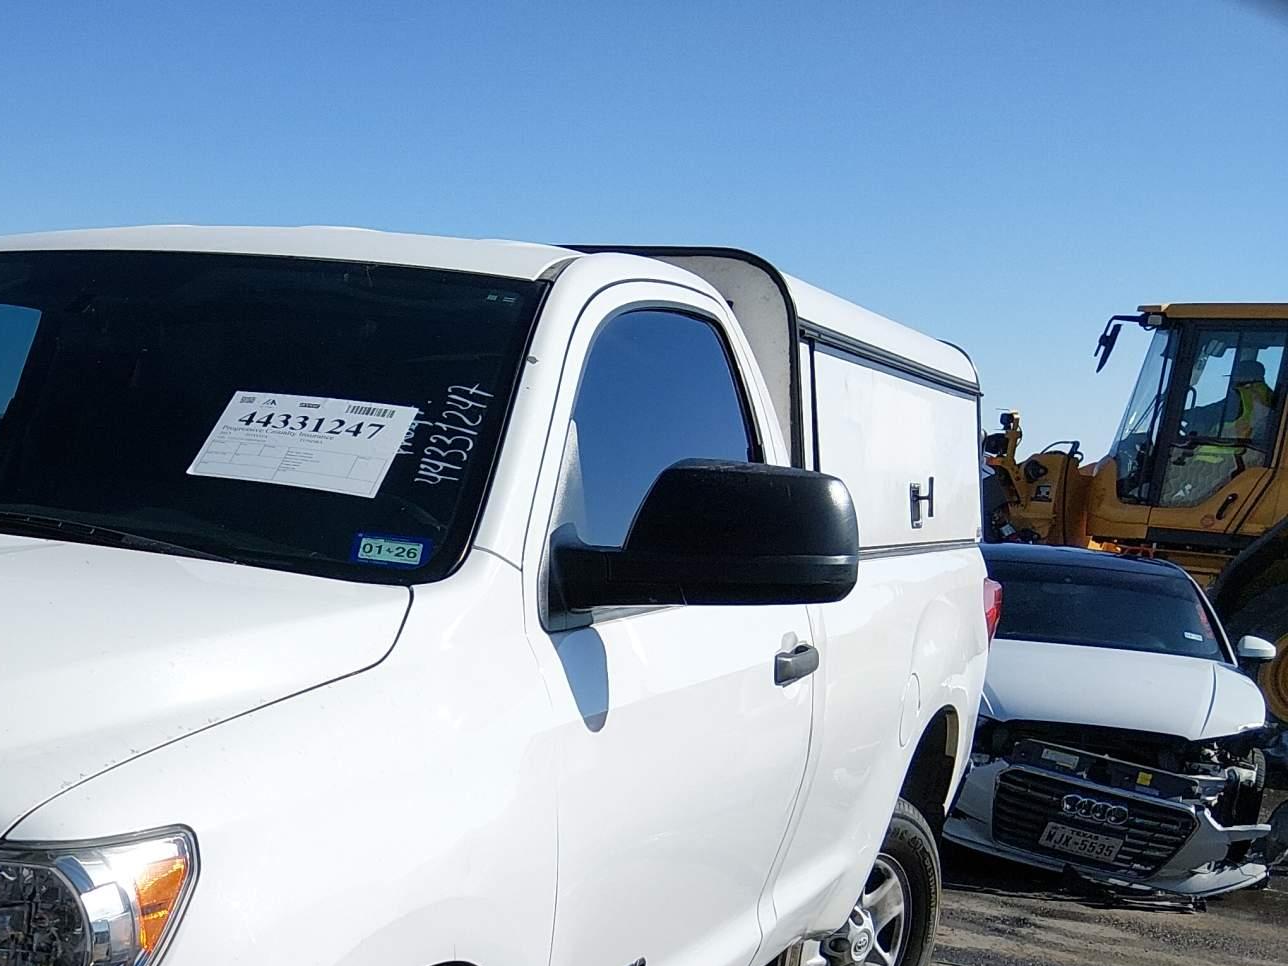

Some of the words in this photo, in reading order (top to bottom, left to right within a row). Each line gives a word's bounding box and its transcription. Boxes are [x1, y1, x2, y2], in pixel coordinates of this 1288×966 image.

[238, 410, 386, 440] 44331247
[414, 383, 495, 485] 44331247
[1071, 830, 1100, 841] TEXAS
